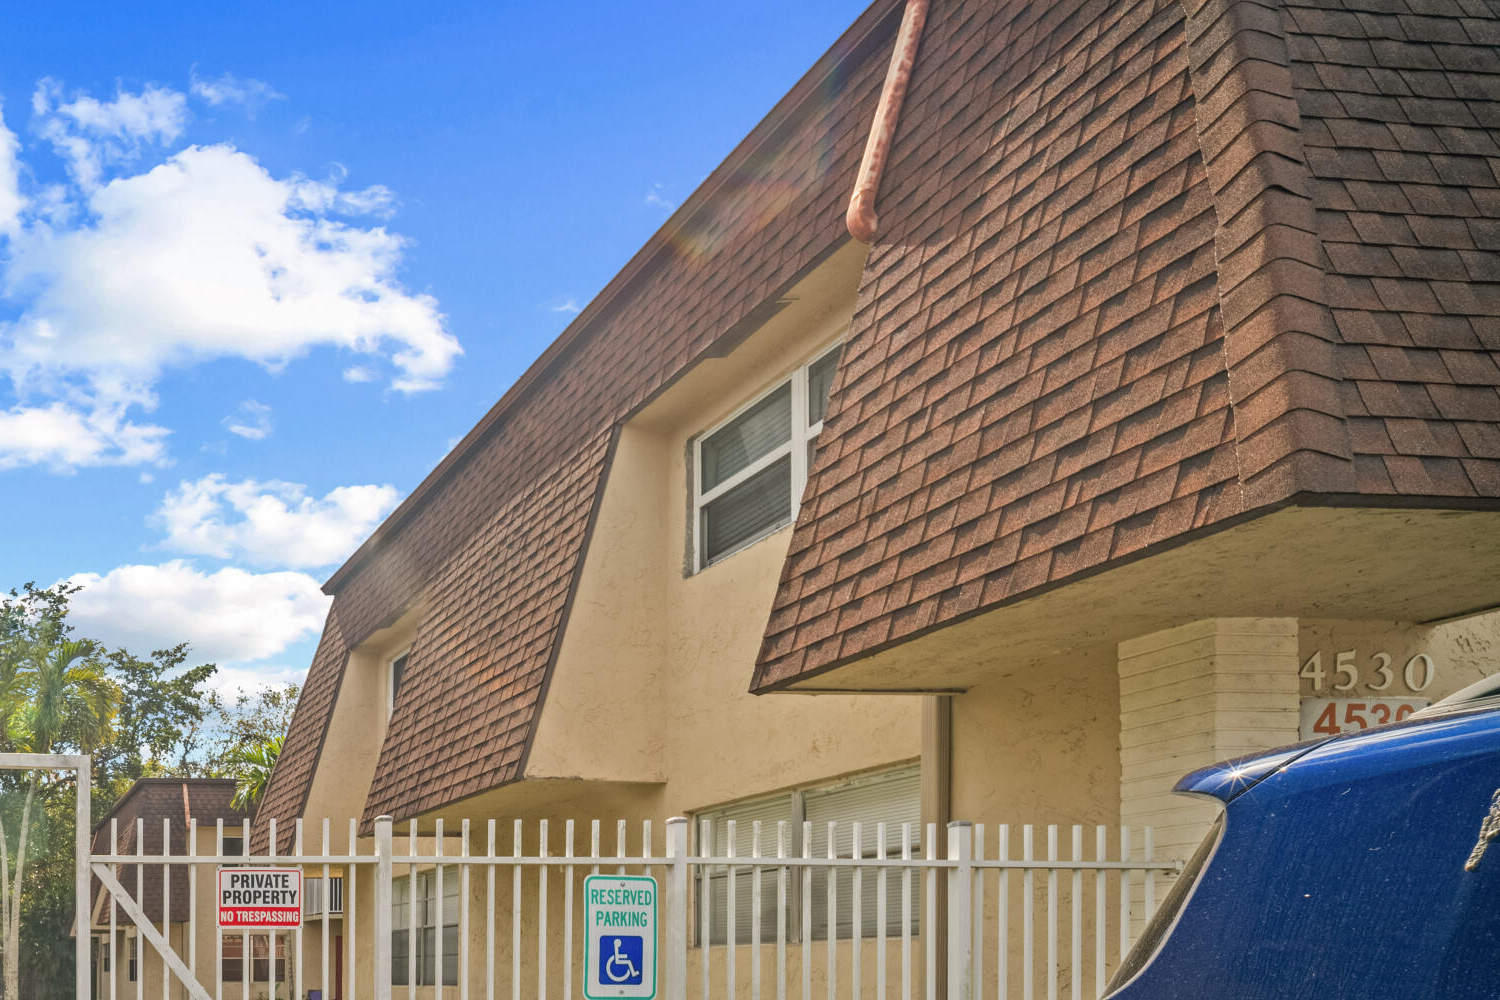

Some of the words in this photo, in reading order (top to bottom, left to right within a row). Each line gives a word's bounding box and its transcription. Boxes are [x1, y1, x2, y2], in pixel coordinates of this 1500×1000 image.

[1300, 649, 1435, 692] 4530
[230, 874, 289, 888] PRIVATE
[222, 890, 297, 905] PROPERTY
[590, 889, 652, 906] RESERVED
[220, 911, 234, 922] NO
[236, 911, 299, 923] TRESPASSING
[595, 910, 648, 927] PARKING
